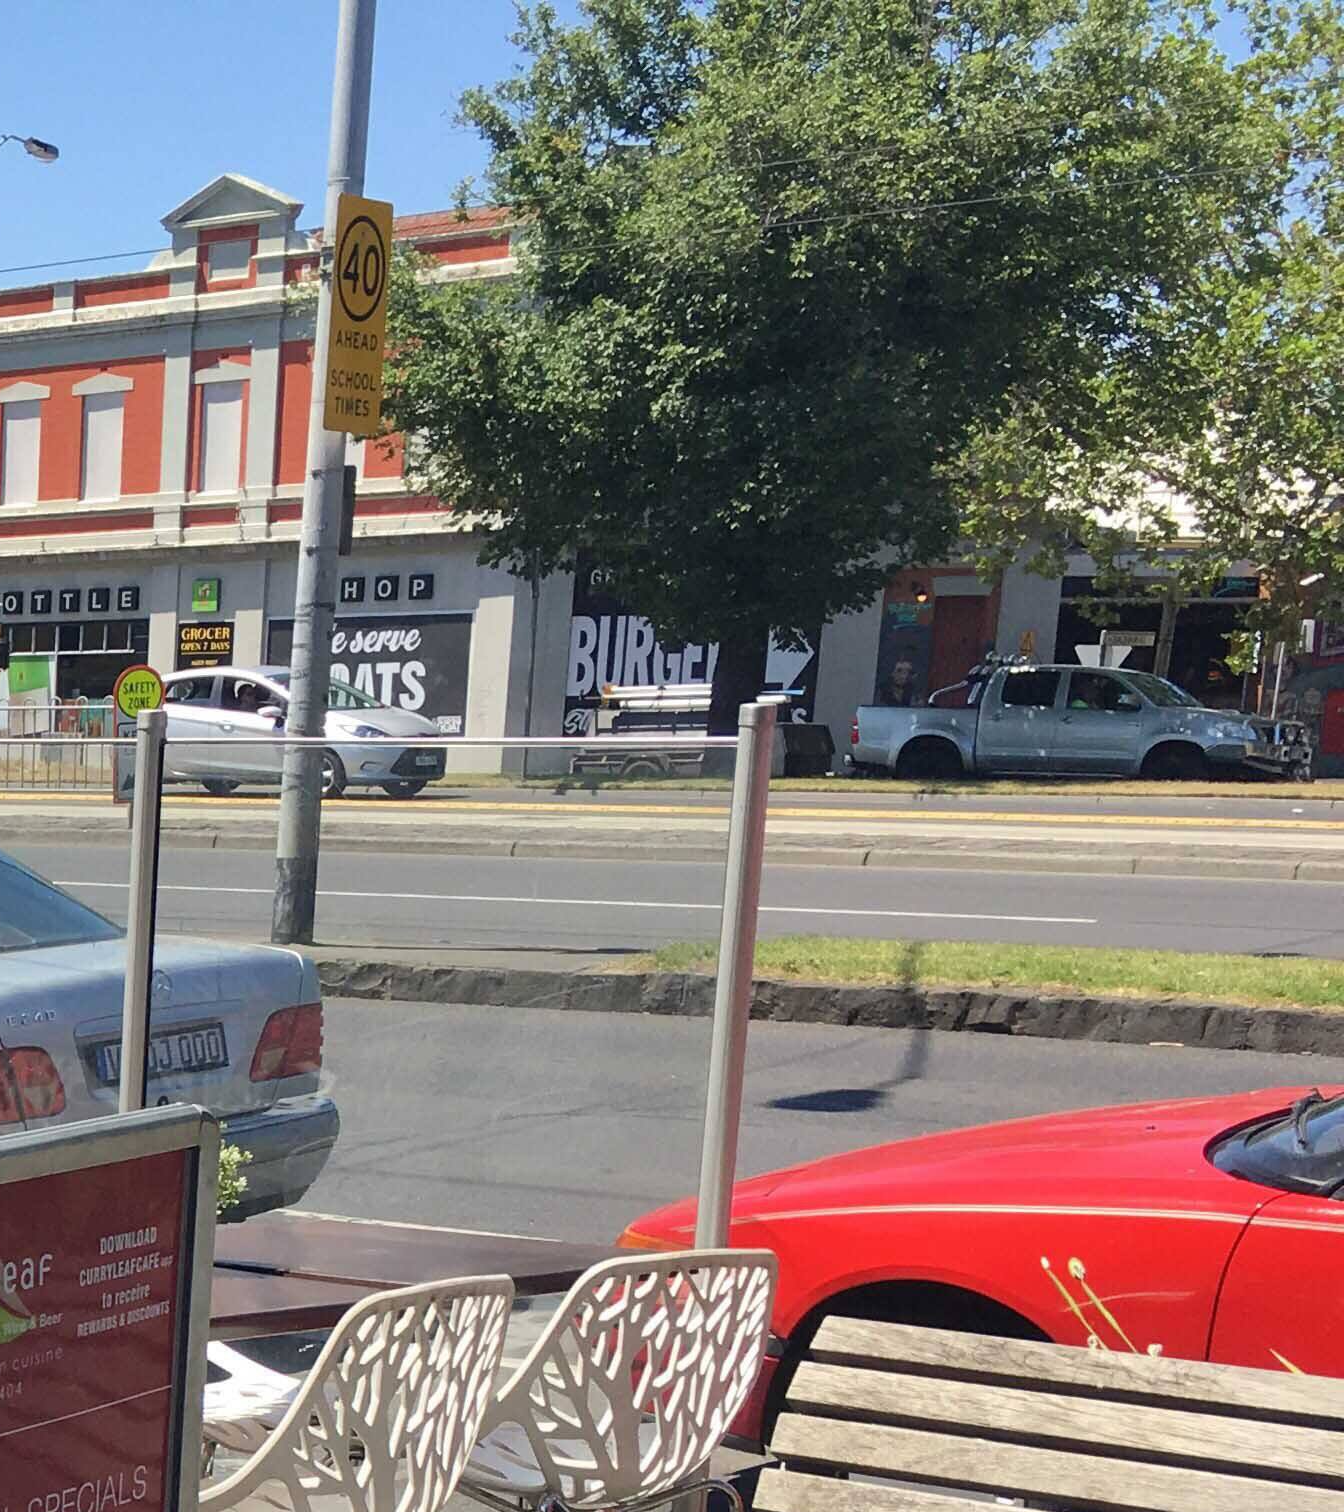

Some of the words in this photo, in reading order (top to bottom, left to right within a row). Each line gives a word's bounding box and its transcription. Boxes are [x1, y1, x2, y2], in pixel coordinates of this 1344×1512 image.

[342, 243, 381, 297] 40
[335, 329, 378, 352] AHEAD
[330, 367, 377, 392] SCHOOL
[335, 396, 369, 418] TIMES
[342, 578, 426, 599] HOP
[180, 642, 202, 651] OPEN
[203, 642, 209, 650] 7
[210, 641, 231, 651] DAYS
[349, 628, 422, 654] serve
[122, 681, 157, 695] SAFETY
[128, 697, 151, 709] ZONE
[99, 1226, 157, 1255] DOWNLOAD
[79, 1252, 160, 1287] CURRYLEAFCAFE
[102, 1292, 113, 1310] to
[114, 1283, 150, 1305] receive
[29, 1315, 37, 1330] &
[39, 1312, 64, 1328] Beer
[77, 1314, 117, 1338] REWARDS
[118, 1312, 126, 1327] &
[127, 1299, 170, 1325] DISCOUNTS
[12, 1346, 64, 1371] cuisine
